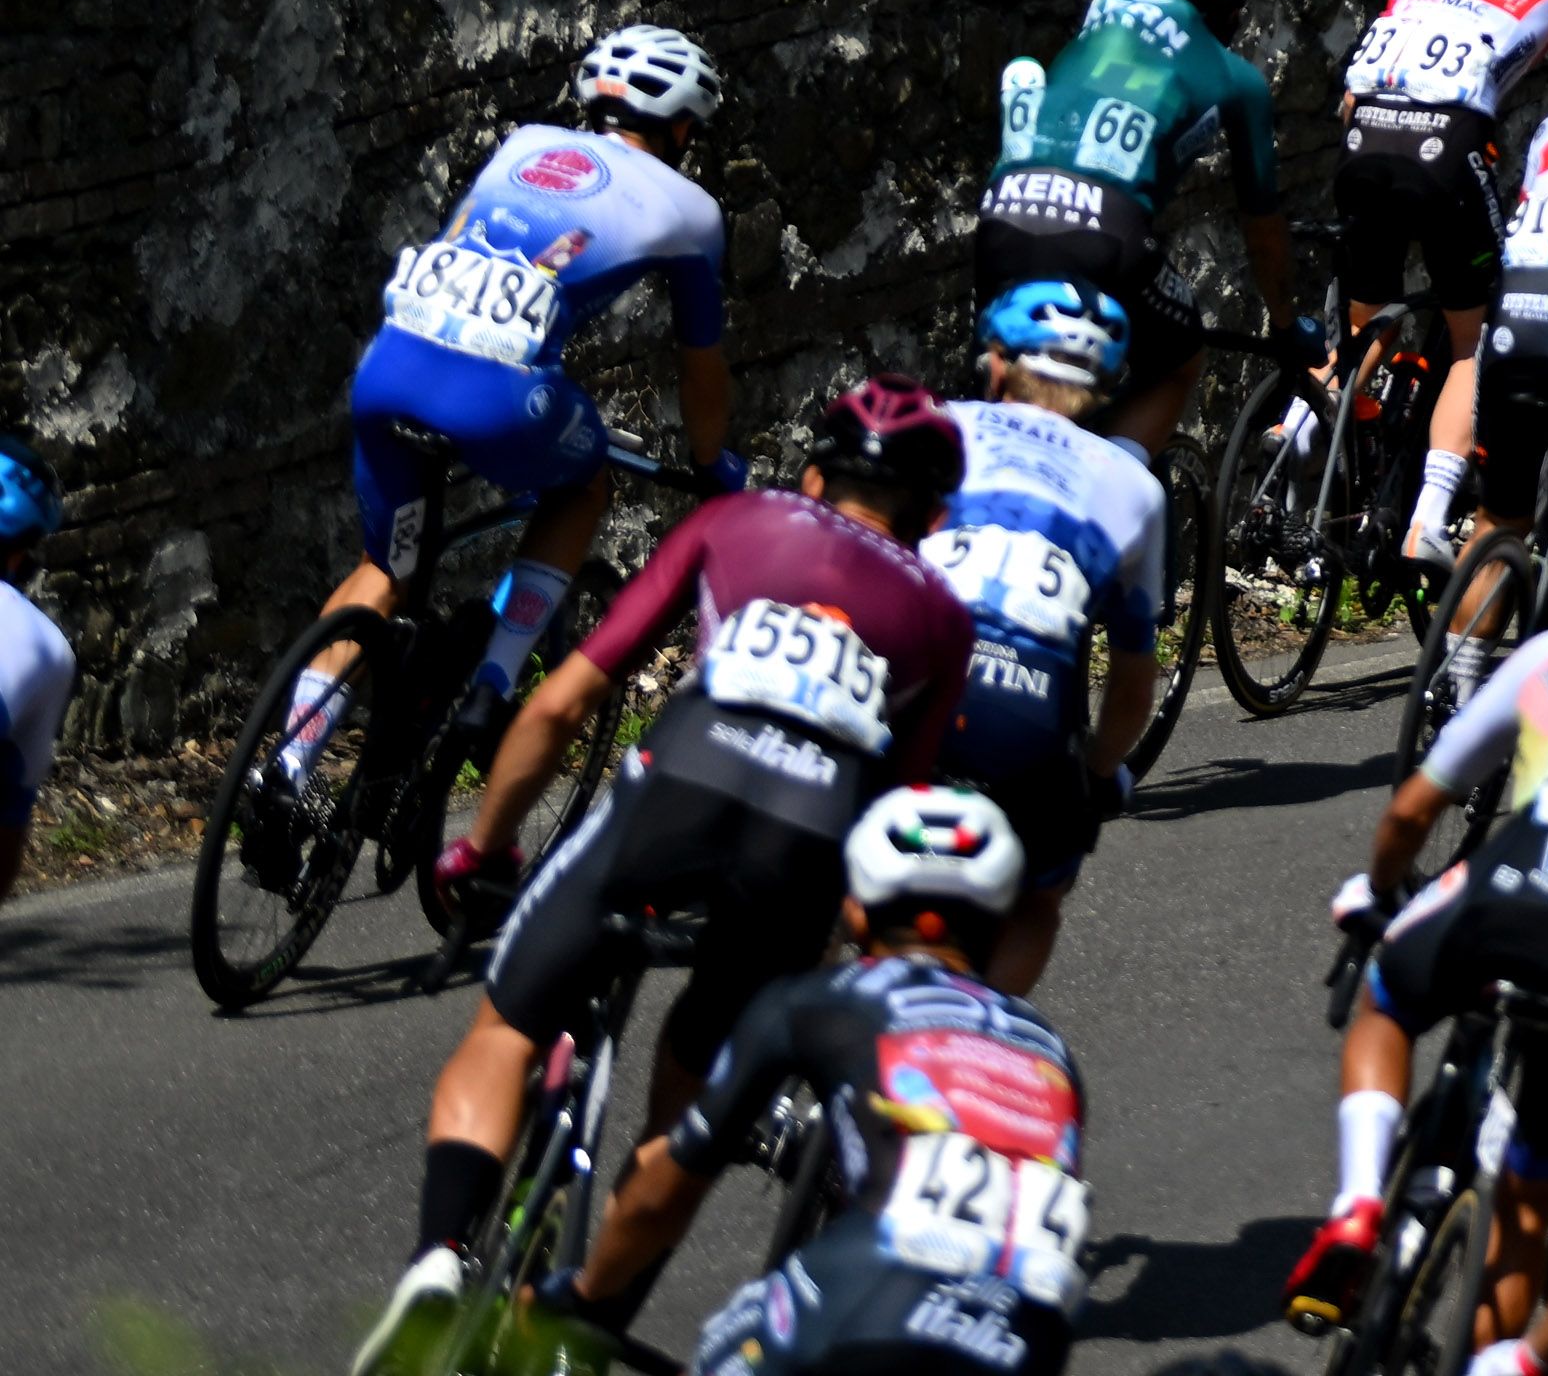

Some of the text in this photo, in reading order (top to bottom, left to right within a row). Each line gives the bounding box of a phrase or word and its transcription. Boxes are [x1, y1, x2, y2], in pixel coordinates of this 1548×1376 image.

[1420, 34, 1472, 77] 93
[1094, 101, 1147, 153] 66
[1355, 105, 1398, 123] SYSTEM
[1398, 109, 1450, 129] CARS.IT
[992, 201, 1102, 231] PHARMA
[998, 172, 1104, 215] KERN
[398, 247, 551, 334] 184 184
[975, 408, 1074, 449] ISRAEL
[1038, 544, 1074, 598] 5
[720, 605, 874, 704] 155 15
[916, 1132, 993, 1226] 42
